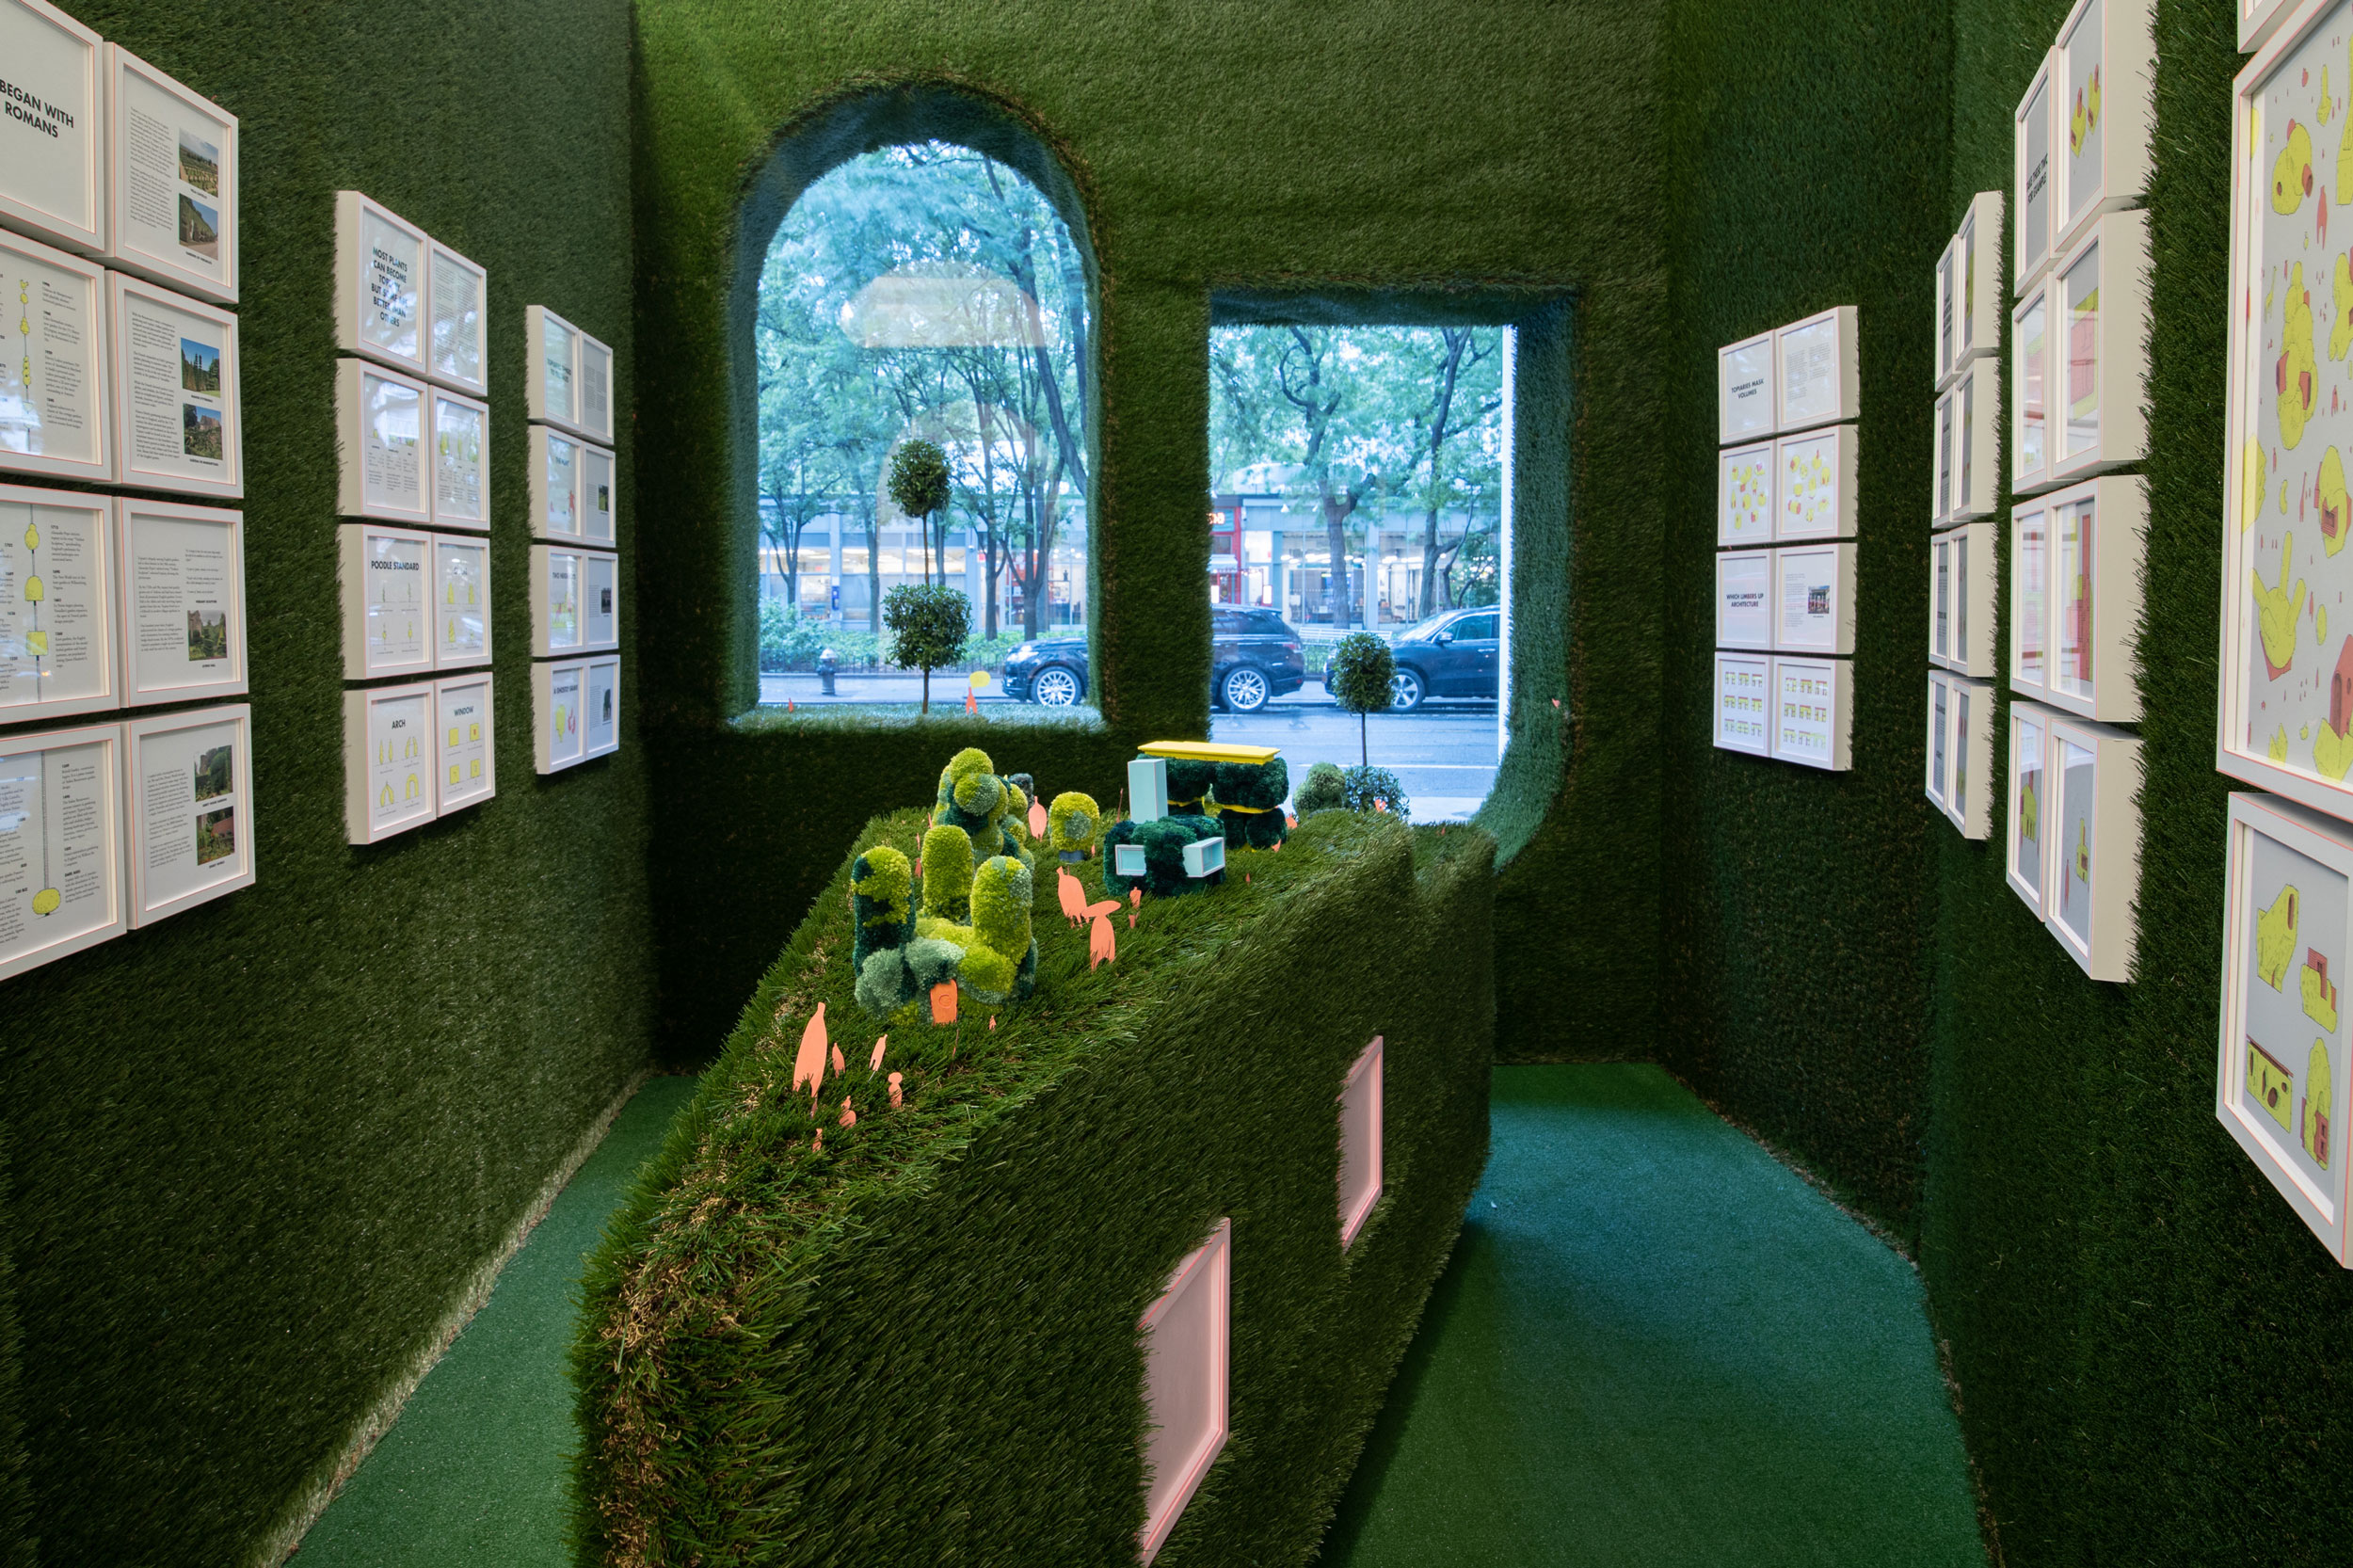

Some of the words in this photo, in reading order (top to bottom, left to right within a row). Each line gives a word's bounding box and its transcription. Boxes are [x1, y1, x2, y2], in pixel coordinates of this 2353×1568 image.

[0, 79, 41, 112] BEGAN
[44, 102, 74, 128] WITH
[5, 101, 58, 138] ROMANS
[373, 247, 388, 262] MOST
[389, 255, 408, 272] PLANTS
[374, 260, 385, 272] CAN
[387, 265, 407, 283] BECOME
[371, 282, 381, 294] BUT
[1737, 389, 1757, 399] VOLUMES
[371, 560, 392, 570] POODLE
[393, 561, 420, 571] STANDARD
[454, 706, 474, 716] WINDOW
[392, 718, 406, 729] ARCH
